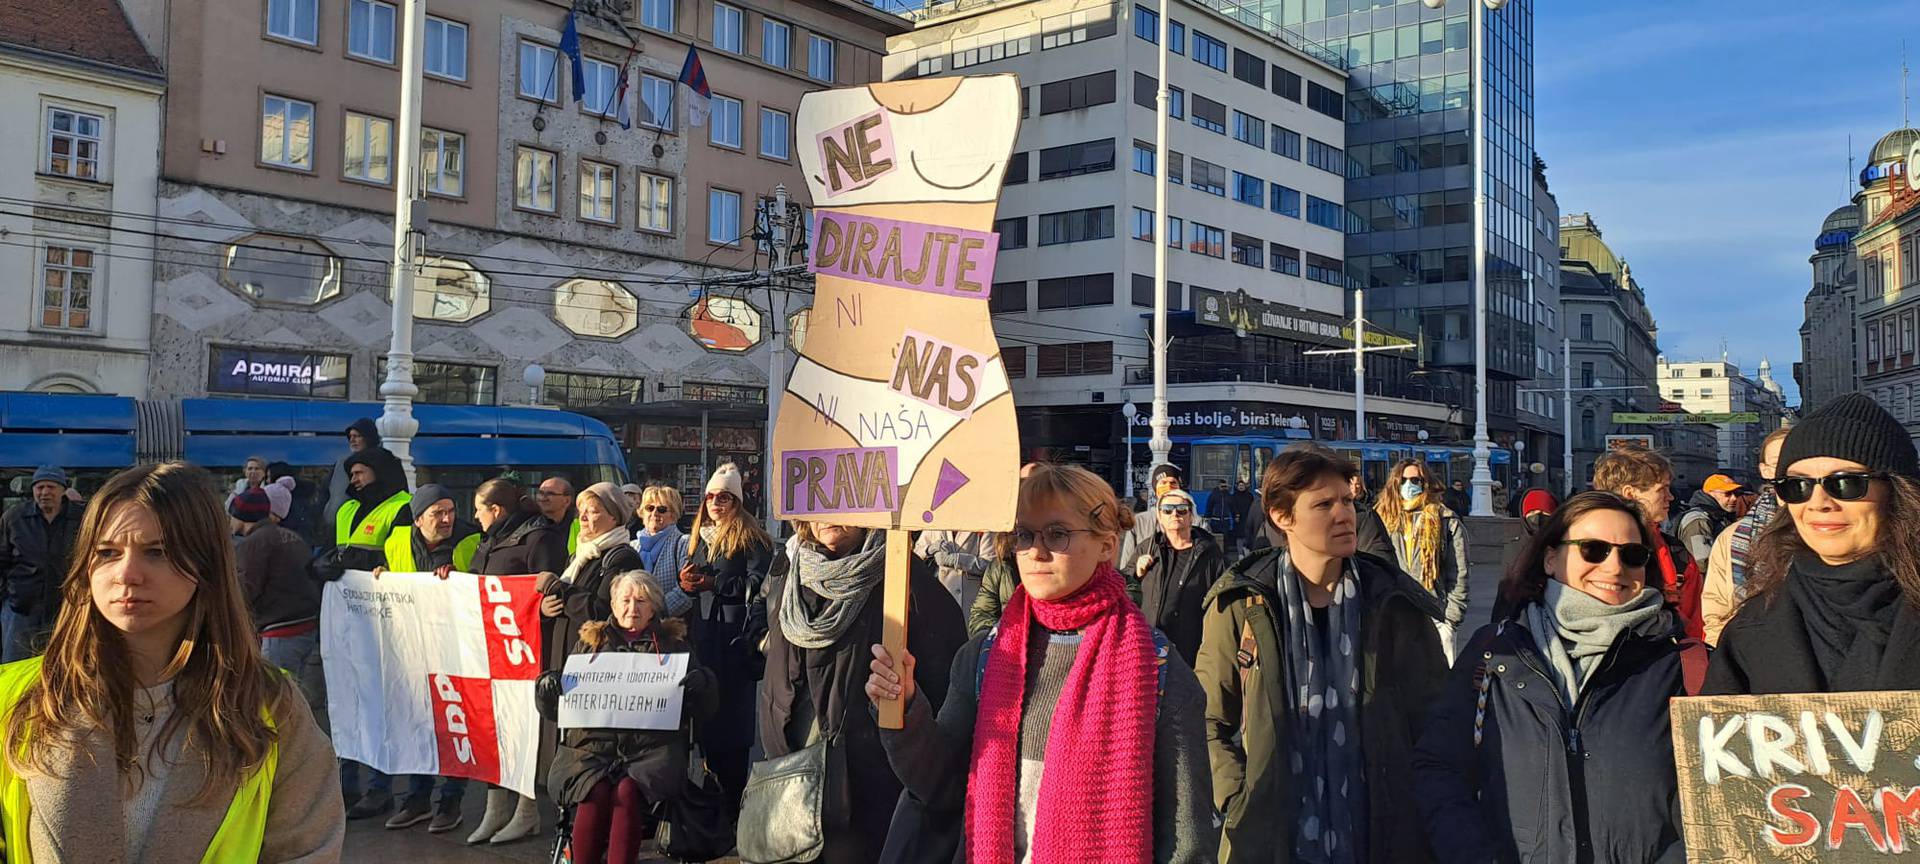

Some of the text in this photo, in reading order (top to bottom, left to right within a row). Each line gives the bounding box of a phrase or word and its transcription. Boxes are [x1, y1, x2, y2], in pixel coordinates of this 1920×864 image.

[822, 112, 893, 192] NE
[815, 216, 985, 293] DIRAJTE
[837, 293, 862, 329] NI
[1262, 310, 1293, 330] UŽIVANJE
[1293, 318, 1298, 331] U
[1299, 320, 1319, 335] RITMU
[231, 359, 328, 381] ADMIRAL
[252, 375, 312, 385] AUTOMAT CLUB
[891, 335, 979, 412] NAS
[814, 392, 932, 441] NI NAŠA
[1131, 413, 1151, 426] Ka
[1194, 411, 1236, 429] bolje,
[1240, 411, 1269, 427] biraš
[785, 450, 893, 511] PRAVA
[484, 575, 536, 665] SDP
[434, 673, 477, 765] SDP
[1699, 709, 1884, 785] KRIV
